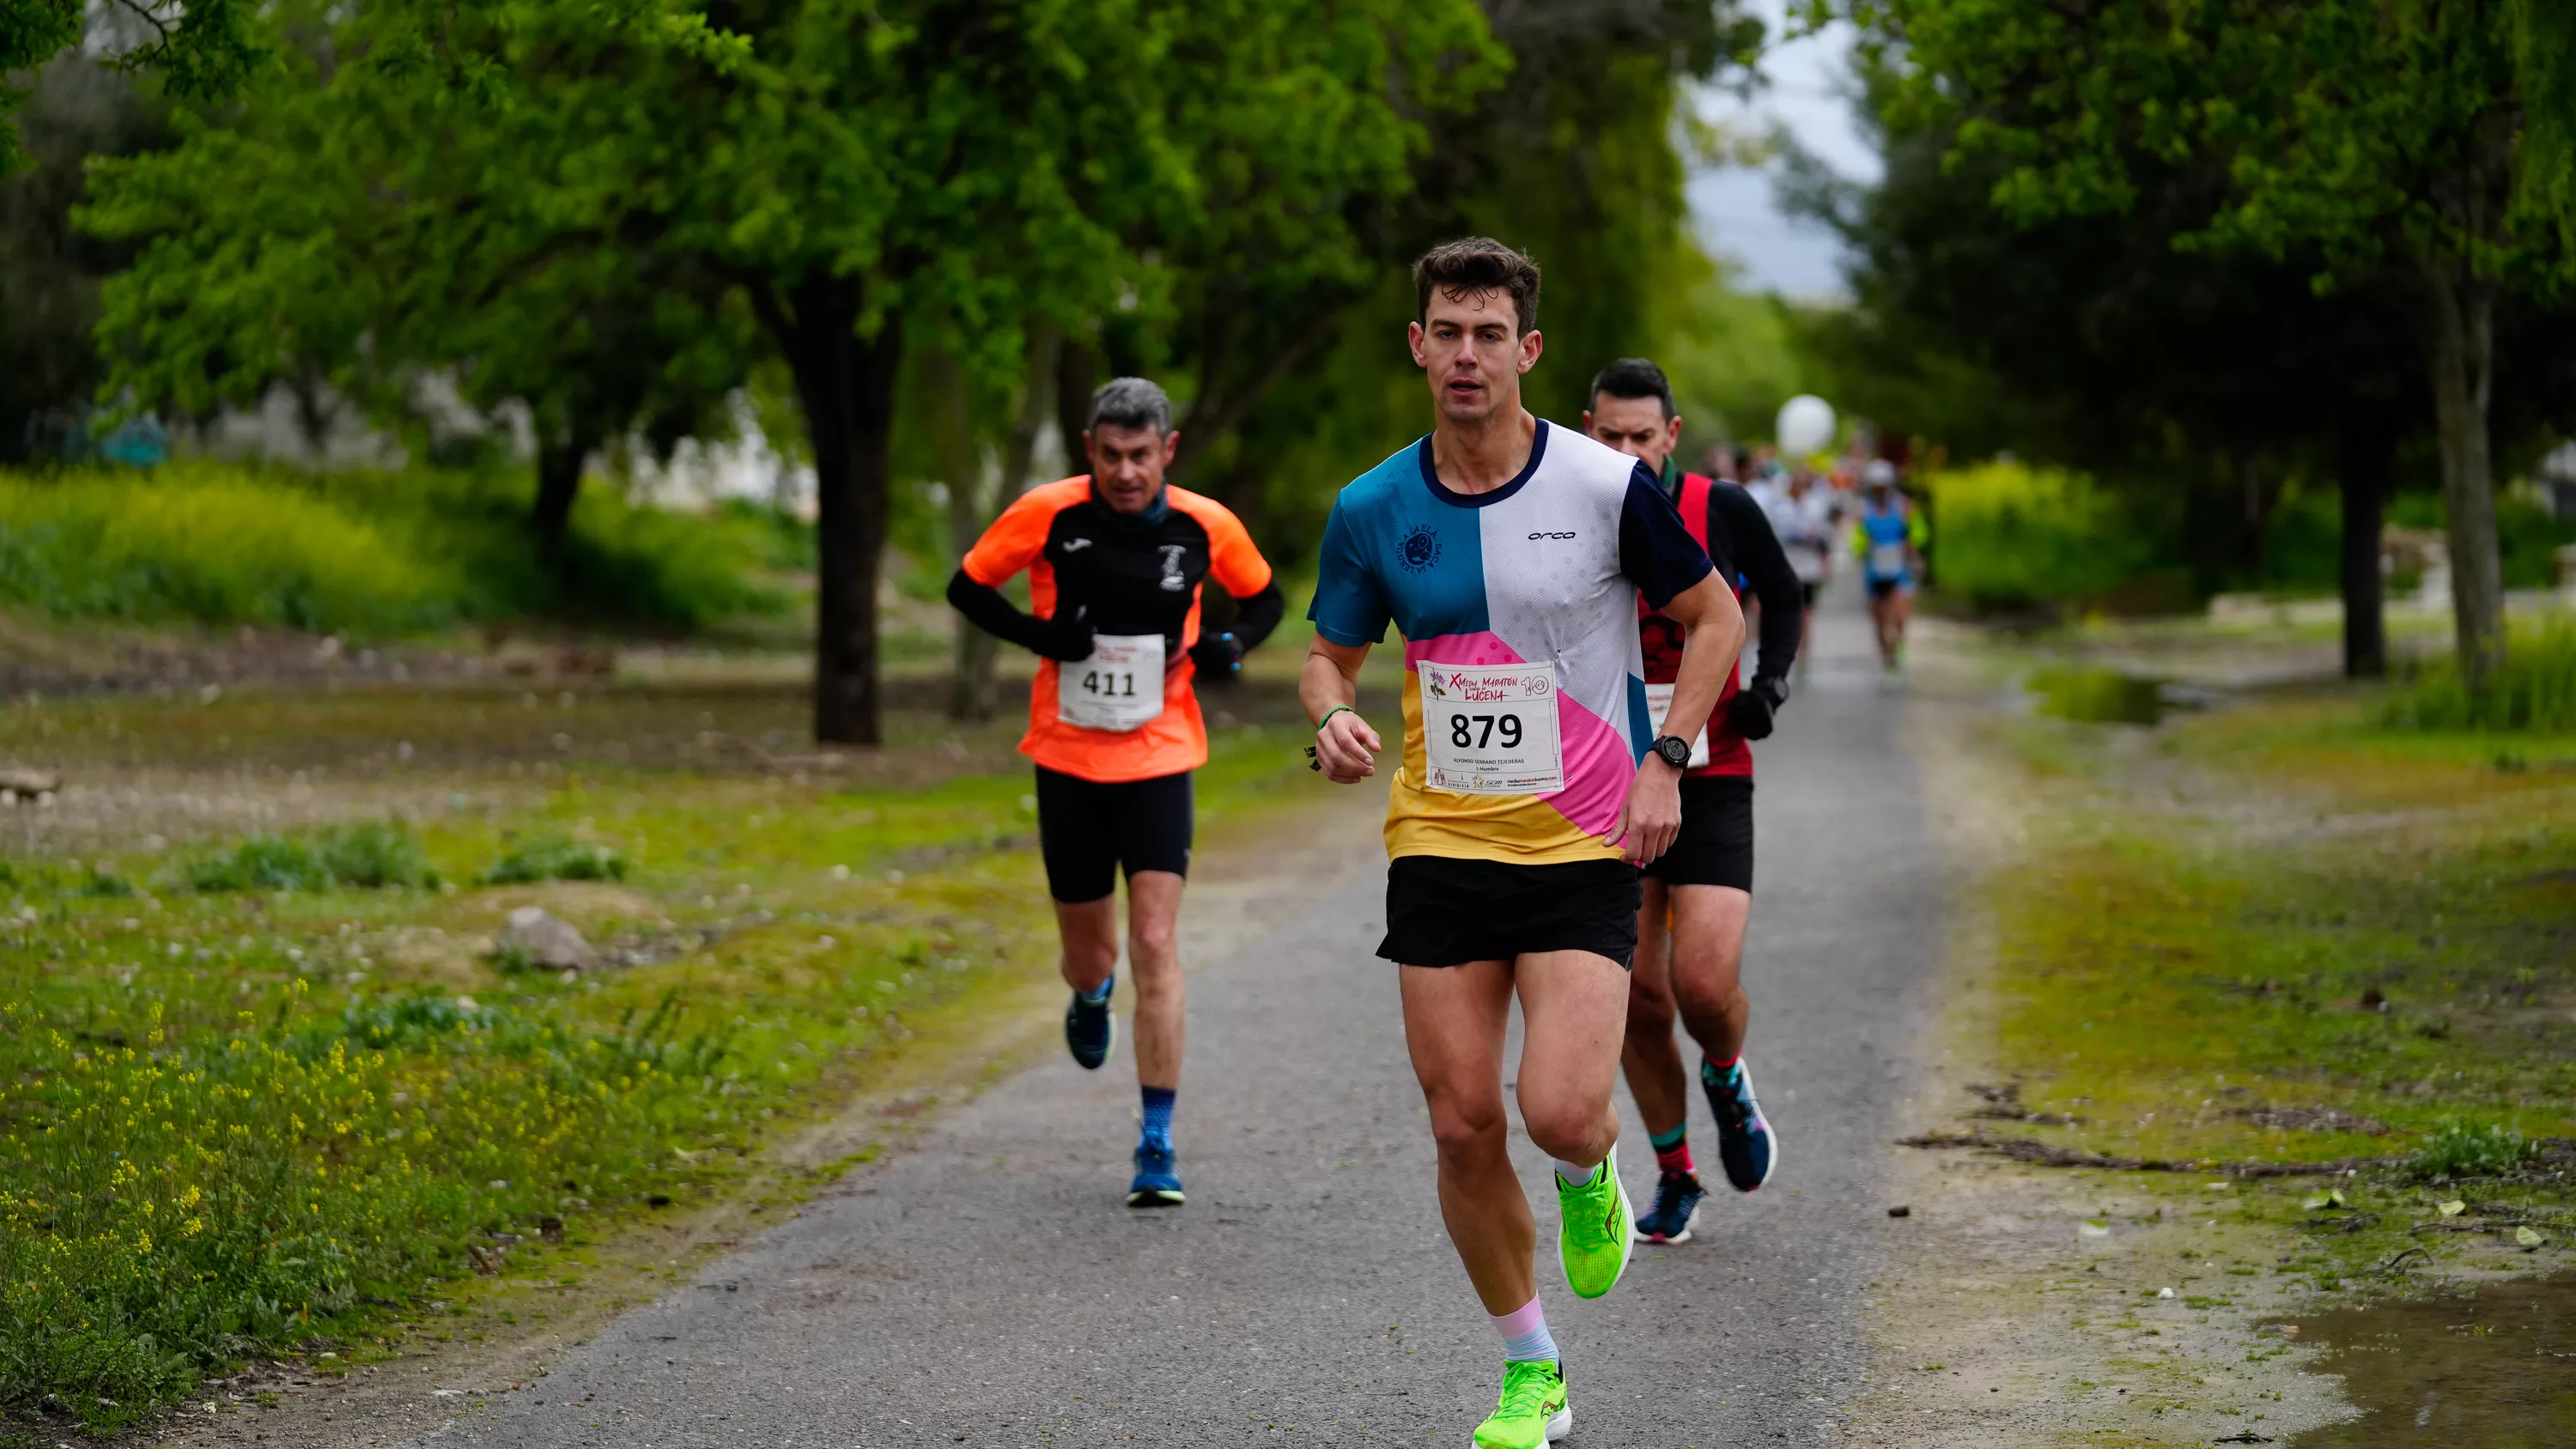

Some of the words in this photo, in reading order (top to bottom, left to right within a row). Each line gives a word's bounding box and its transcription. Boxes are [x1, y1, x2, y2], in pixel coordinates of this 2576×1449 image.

[1528, 531, 1576, 540] orca
[1427, 544, 1443, 567] SACA
[1083, 670, 1136, 696] 411
[1465, 688, 1510, 702] LUCENA
[1451, 714, 1522, 749] 879
